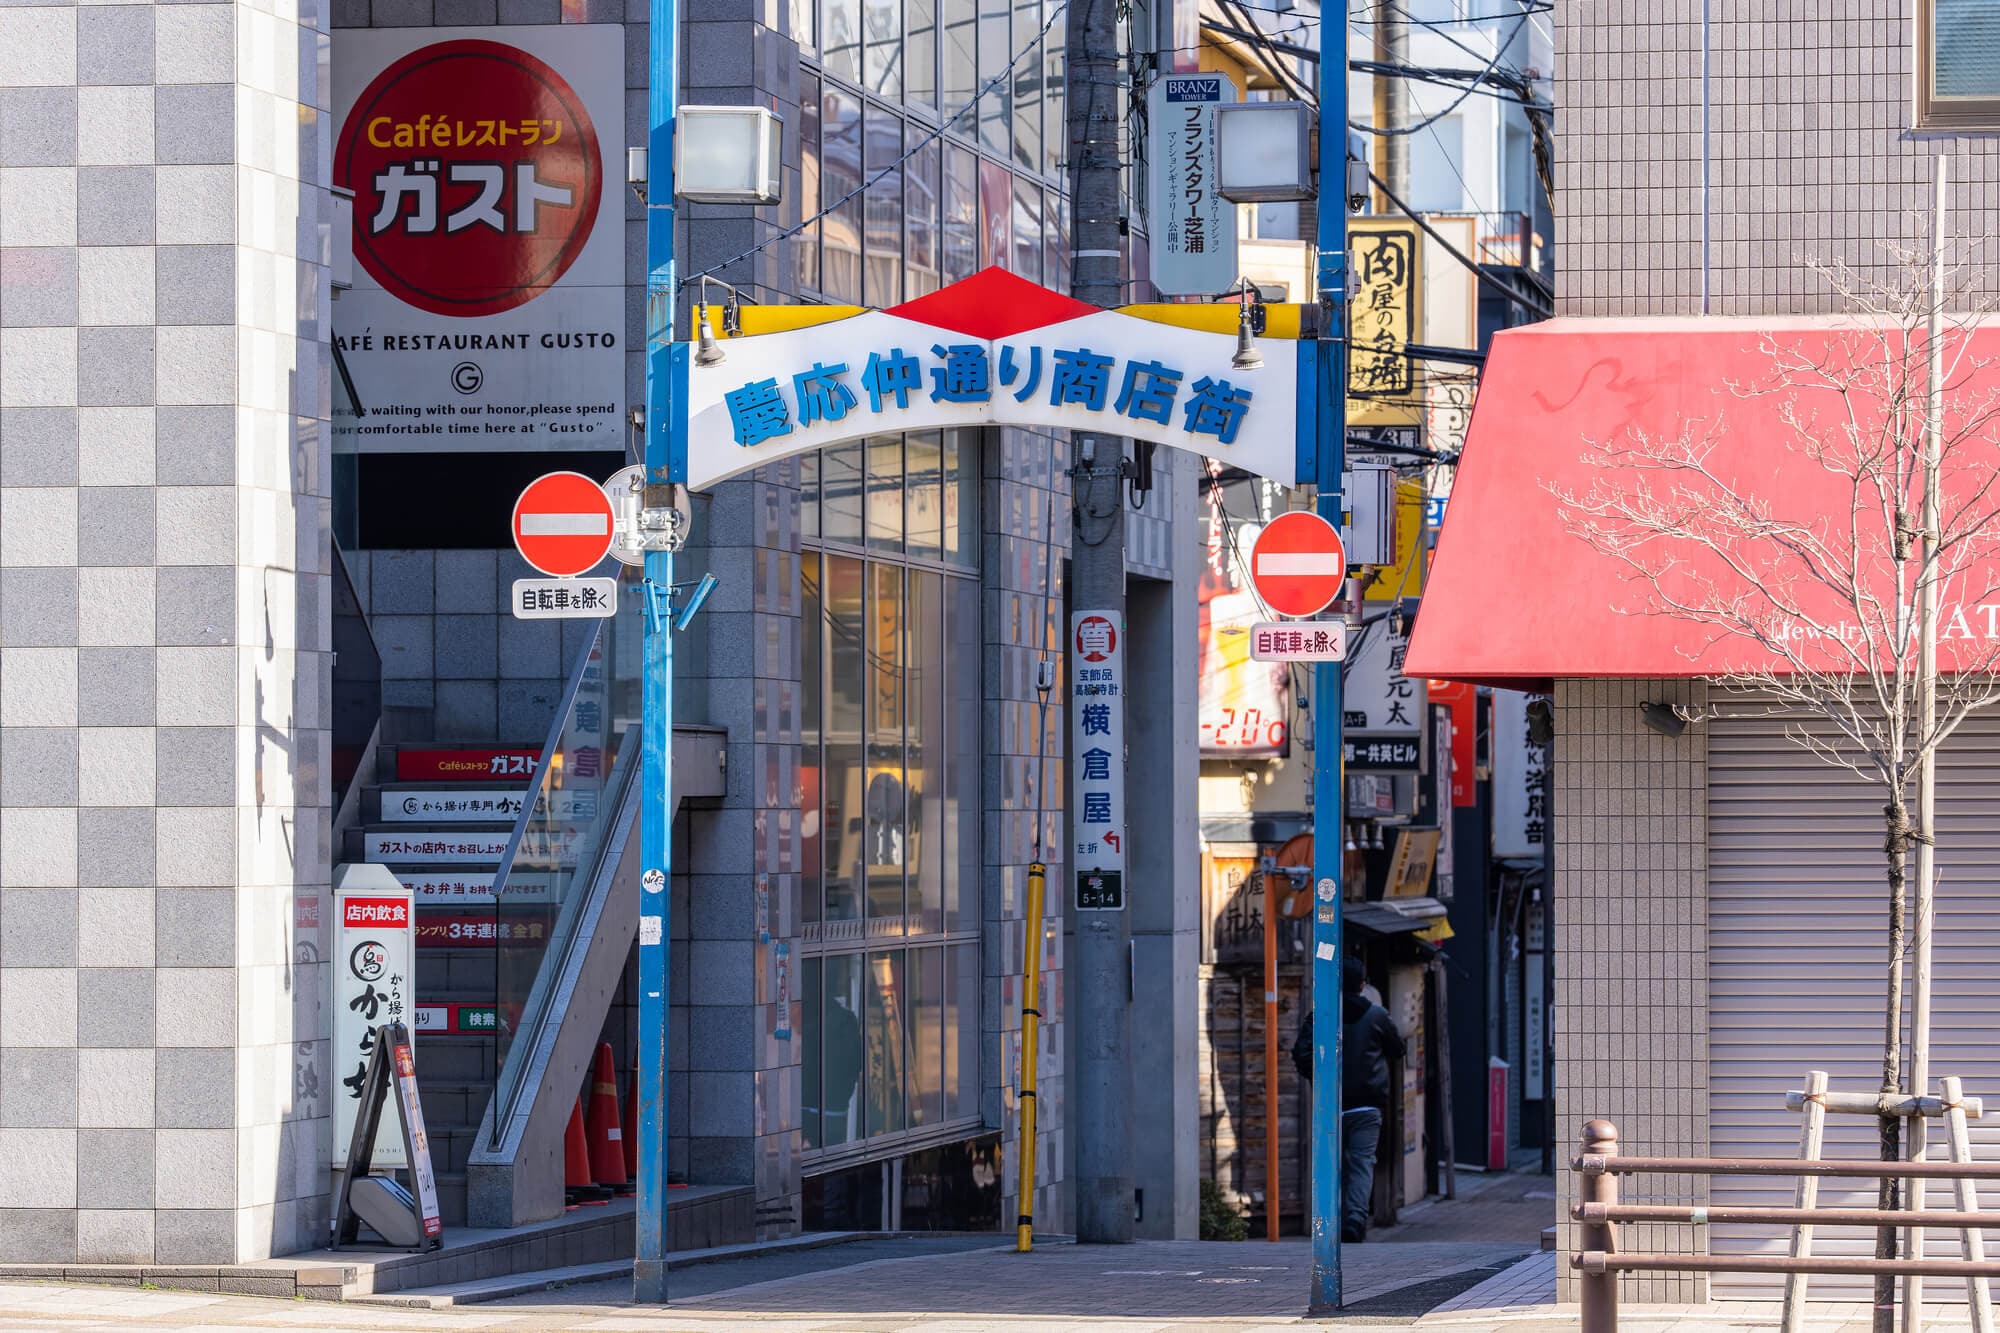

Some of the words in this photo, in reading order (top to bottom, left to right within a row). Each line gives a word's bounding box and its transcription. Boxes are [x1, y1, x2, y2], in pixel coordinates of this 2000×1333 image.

[1169, 80, 1217, 93] BRANZ
[1184, 105, 1204, 253] ブランズタワー芝浦
[370, 159, 573, 235] ガスト
[1167, 131, 1178, 253] マンションギャラリー公開中
[336, 327, 373, 350] AFÉ
[384, 334, 530, 350] RESTAURANT
[541, 333, 616, 349] GUSTO
[724, 343, 1254, 447] 慶応仲通り商店街
[371, 404, 421, 418] waiting
[427, 404, 454, 415] with
[460, 406, 482, 415] our
[576, 403, 615, 417] spend
[357, 422, 443, 434] comfortable
[448, 422, 480, 433] time
[485, 422, 515, 433] here
[521, 423, 535, 433] at
[522, 587, 608, 611] 自転車を除く
[1257, 631, 1338, 655] 自転車を除く
[1080, 669, 1112, 681] 宝飾品
[1075, 683, 1118, 696] 高級時計
[1344, 744, 1417, 763] 第一共英ビル
[490, 755, 538, 774] ガスト
[1081, 703, 1112, 824] 横倉屋
[422, 799, 494, 812] から揚げ専門
[1077, 842, 1098, 854] 左折
[1083, 893, 1114, 904] 5-14
[346, 905, 406, 921] 店内飲食
[469, 1012, 495, 1026] 検索
